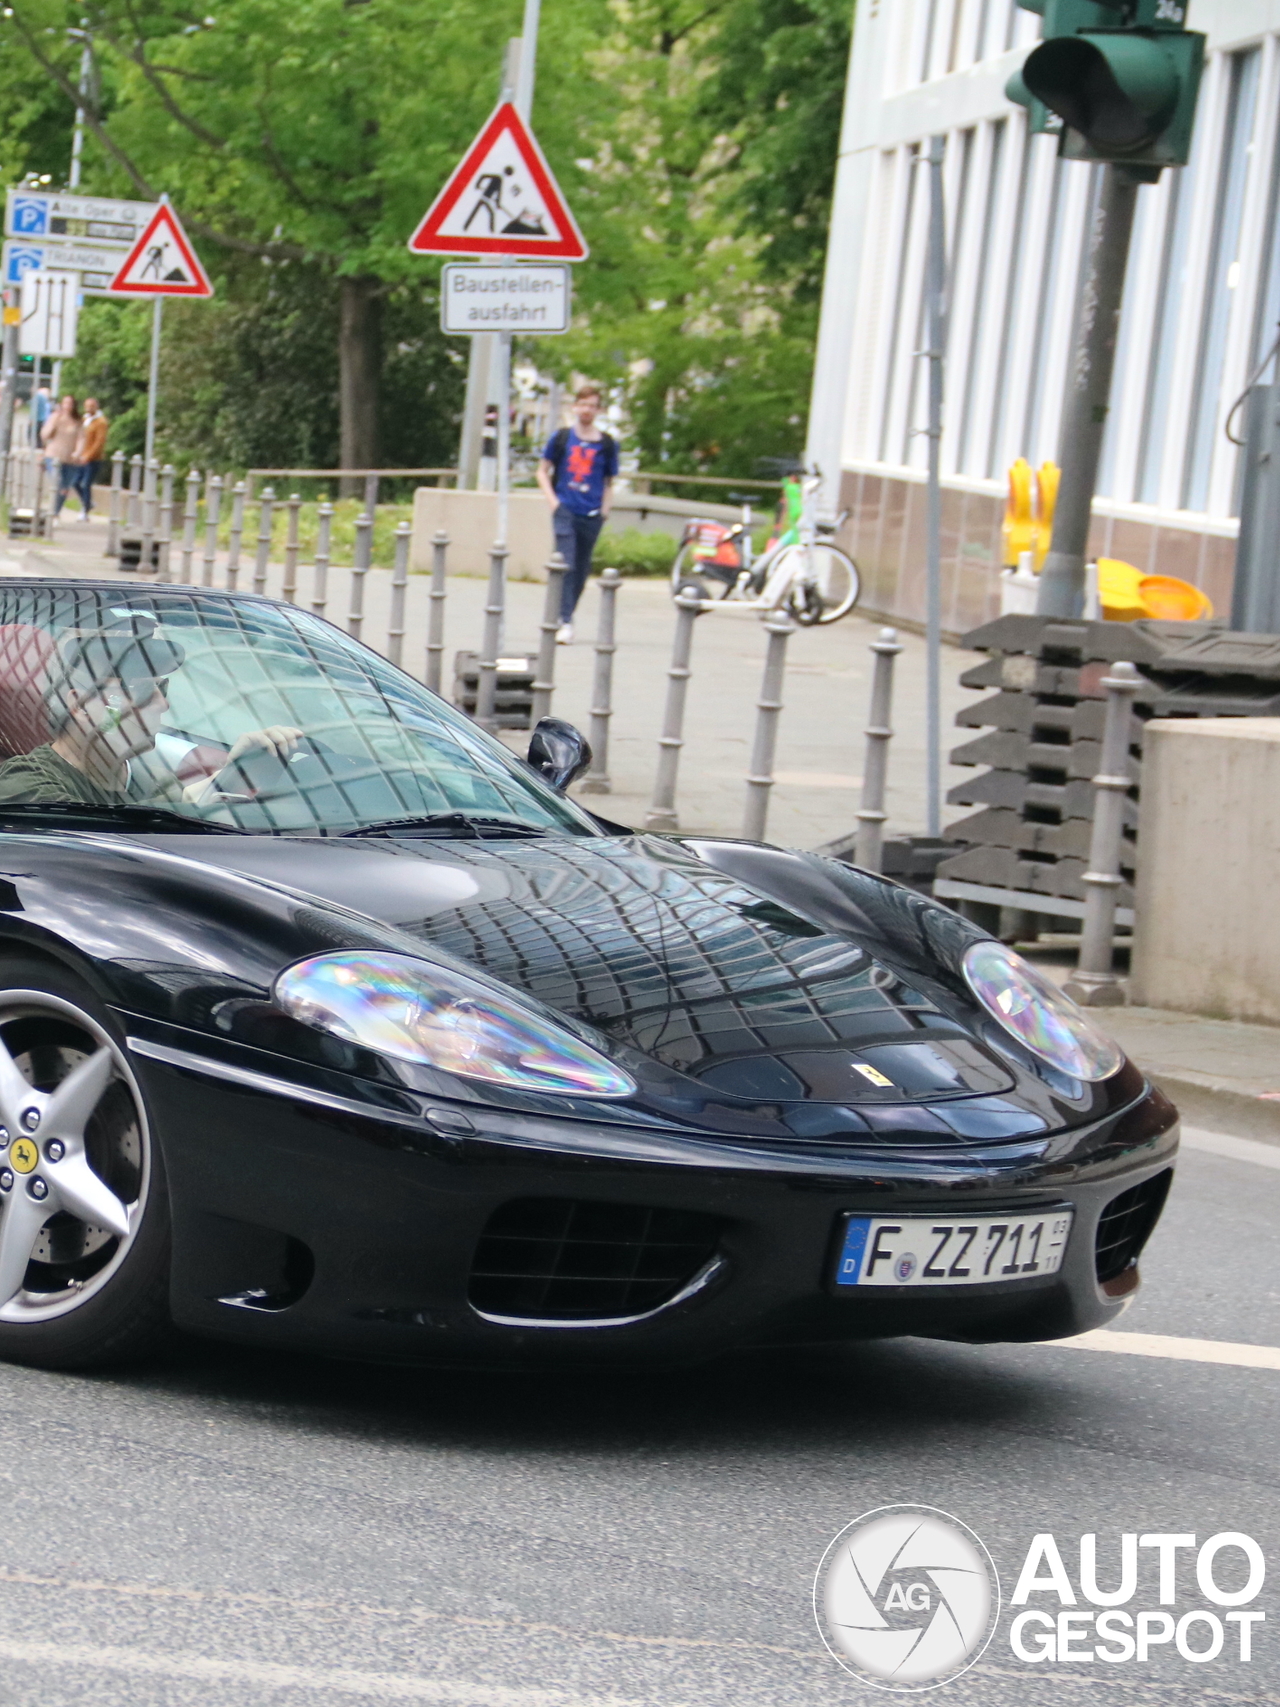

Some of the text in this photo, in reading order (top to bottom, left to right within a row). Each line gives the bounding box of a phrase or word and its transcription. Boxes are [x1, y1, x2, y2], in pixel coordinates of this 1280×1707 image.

[51, 202, 115, 220] Alte Oper
[47, 249, 105, 267] TRIANON
[453, 274, 563, 293] Baustellen-
[468, 302, 547, 321] ausfahrt
[866, 1221, 1045, 1278] F ZZ 711
[842, 1258, 856, 1274] D
